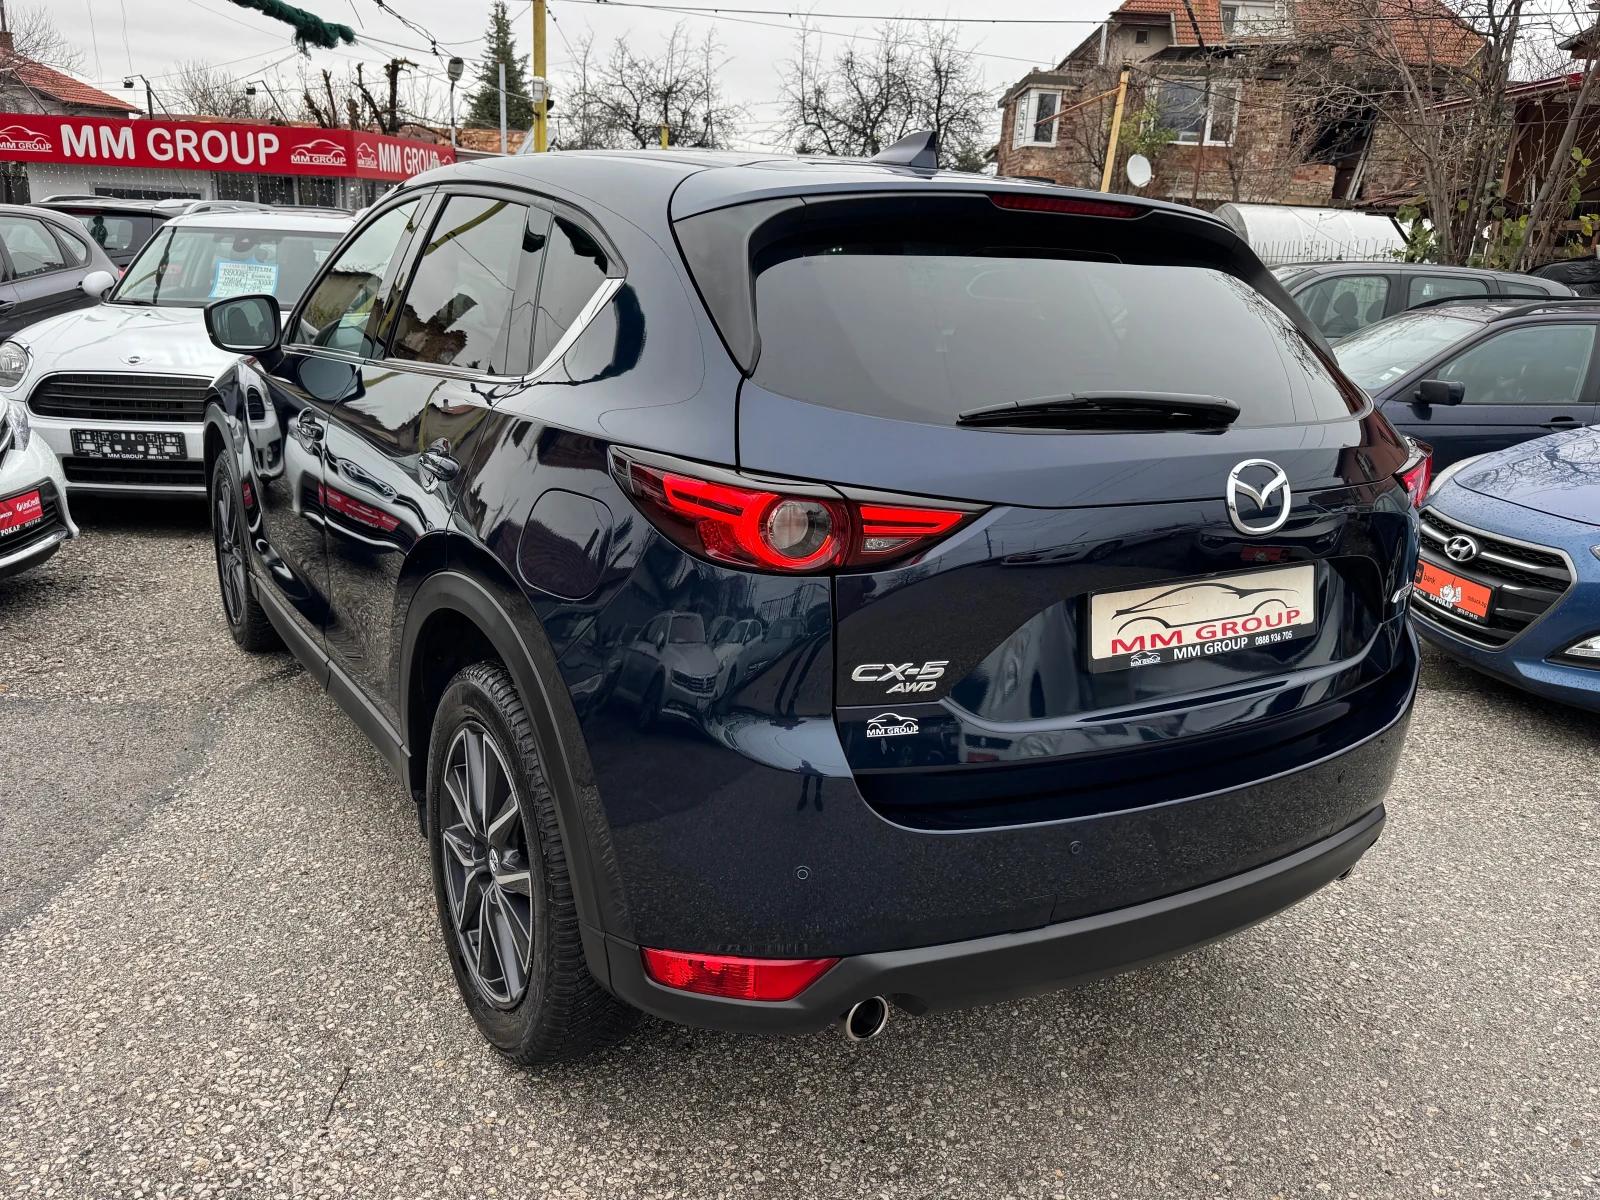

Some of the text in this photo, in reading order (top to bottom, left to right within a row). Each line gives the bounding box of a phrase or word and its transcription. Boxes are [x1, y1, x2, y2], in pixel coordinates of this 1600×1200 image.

[18, 142, 52, 151] GROUP
[60, 124, 280, 166] MM GROUP
[291, 155, 346, 165] MM GROUP
[378, 142, 402, 174] MM
[1423, 572, 1436, 585] bank
[1111, 609, 1300, 654] MM GROUP
[1173, 646, 1200, 660] MM
[1203, 637, 1248, 654] GROUP
[1255, 635, 1270, 645] 0888
[1271, 632, 1281, 642] 936
[851, 660, 950, 682] CX-5
[886, 681, 937, 694] AWD
[867, 725, 919, 736] MM GROUP
